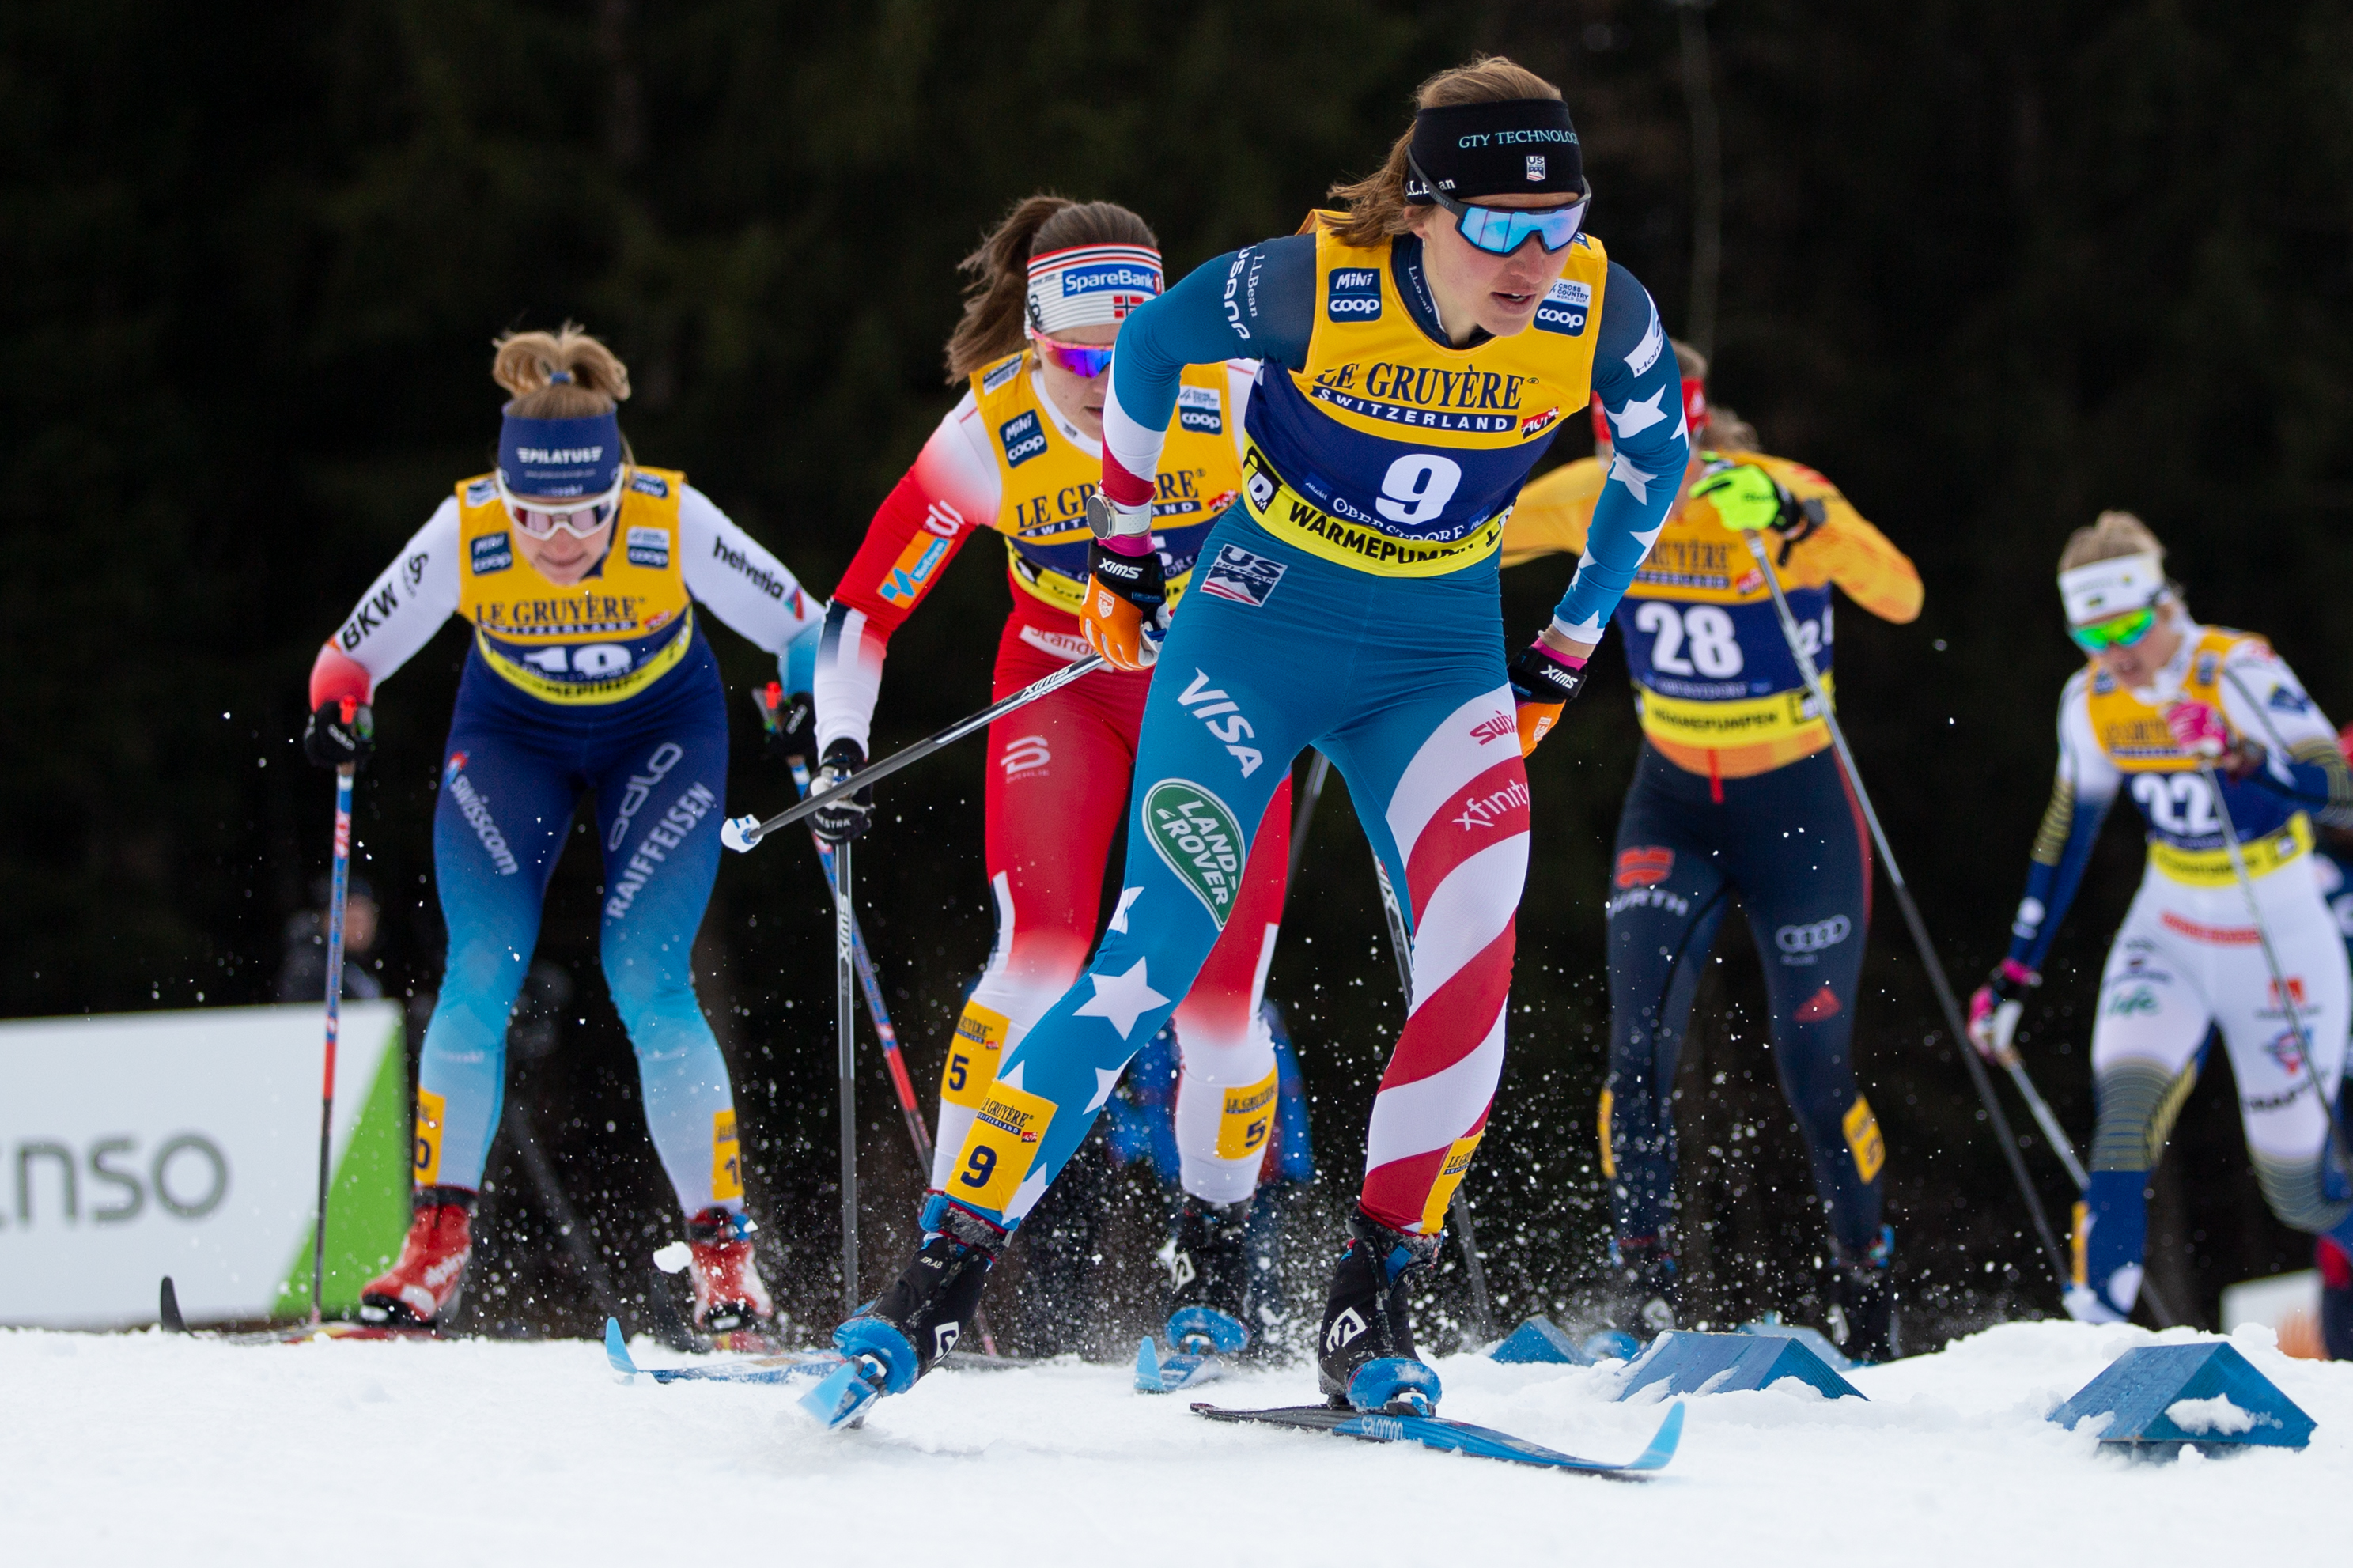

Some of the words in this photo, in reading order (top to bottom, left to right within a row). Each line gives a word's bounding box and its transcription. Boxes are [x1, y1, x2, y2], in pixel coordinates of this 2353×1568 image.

[1458, 134, 1490, 148] GTY
[1065, 269, 1154, 293] SpareBank
[1557, 289, 1589, 300] COUNTRY
[1558, 283, 1581, 293] CROSS
[1330, 299, 1379, 314] coop
[1537, 308, 1584, 328] coop
[1315, 363, 1360, 389] LE
[1365, 362, 1525, 410] GRUYÈRE
[1182, 412, 1220, 429] coop
[1318, 388, 1508, 431] SWITZERLAND
[529, 448, 592, 464] PILATUS
[1008, 435, 1045, 460] coop
[1375, 454, 1462, 525] 9
[1016, 495, 1052, 529] LE
[713, 535, 785, 600] helvetia
[1220, 546, 1283, 579] US
[342, 581, 399, 652] BKW
[476, 603, 505, 625] LE
[1635, 601, 1744, 678] 28
[1178, 667, 1263, 779] VISA
[1451, 779, 1530, 831] xfinity
[2132, 772, 2223, 837] 22
[450, 775, 519, 875] swisscom
[1177, 800, 1237, 873] LAND
[606, 781, 716, 919] RAIFFEISEN
[1161, 818, 1229, 905] ROVER
[949, 1053, 970, 1091] 5
[1245, 1116, 1268, 1148] 5
[960, 1145, 997, 1188] 9
